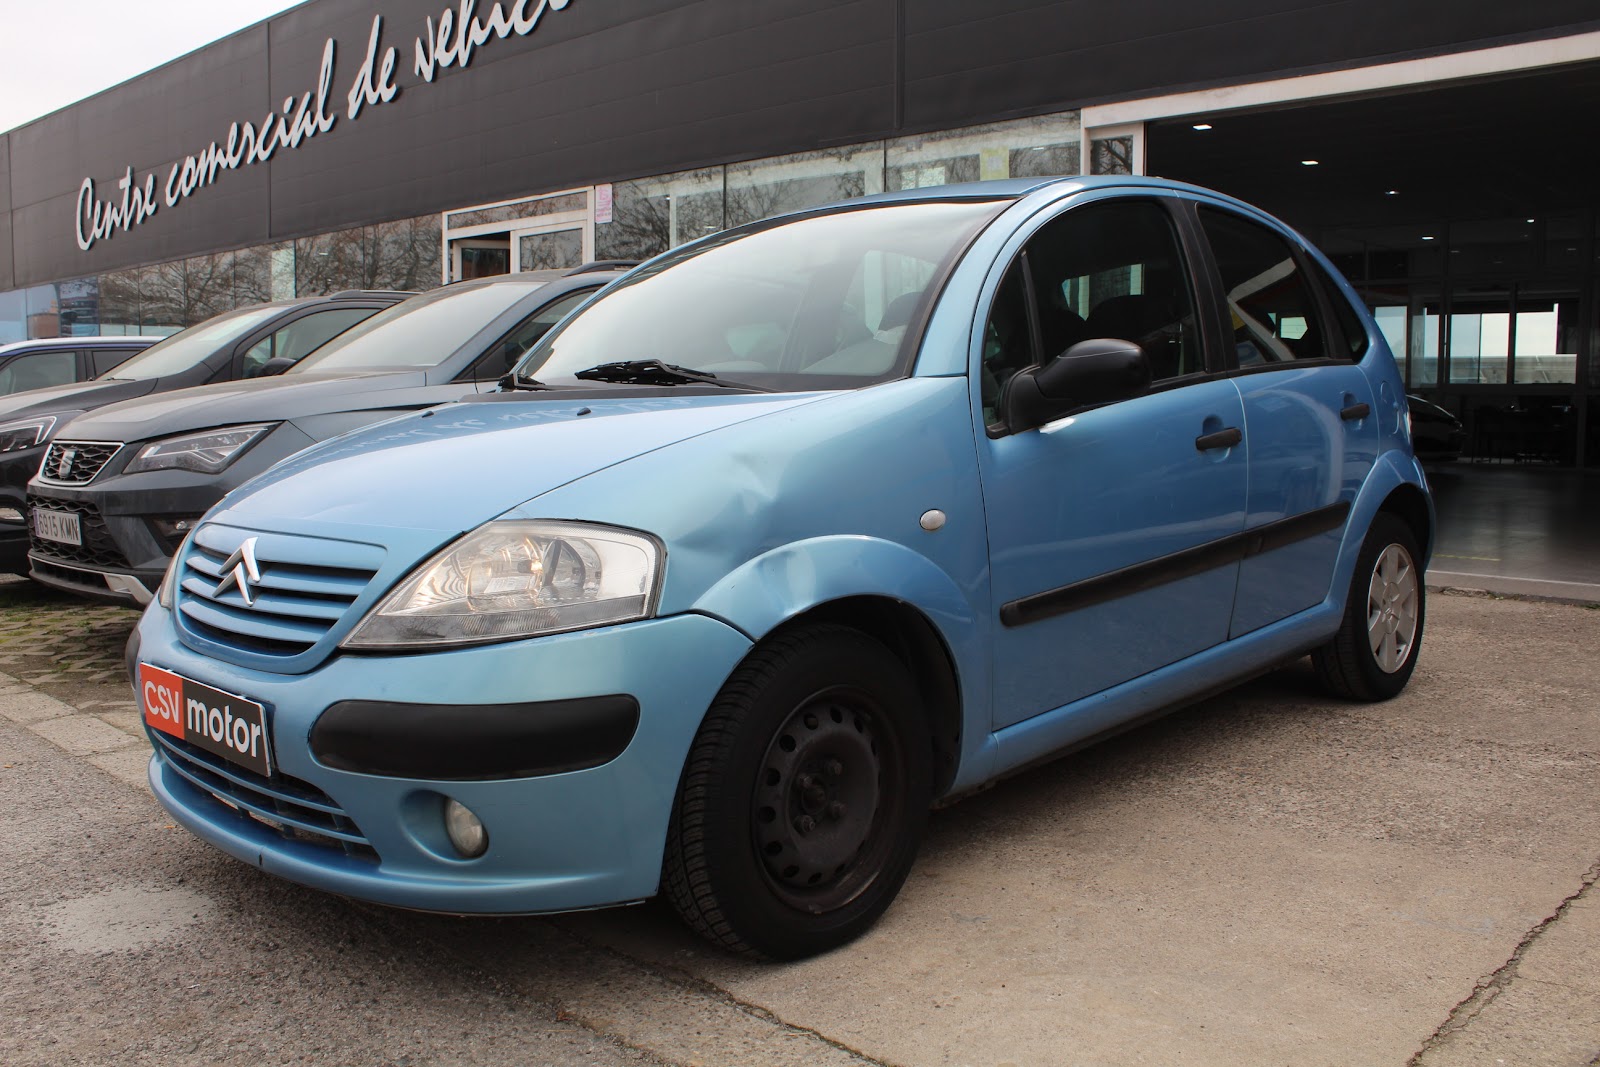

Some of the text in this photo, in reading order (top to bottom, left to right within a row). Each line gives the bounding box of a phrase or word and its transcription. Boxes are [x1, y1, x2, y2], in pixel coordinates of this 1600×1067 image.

[76, 0, 568, 250] Centre comercial de vehic
[39, 514, 79, 541] 6915 KMN
[144, 681, 261, 758] CSV motor
